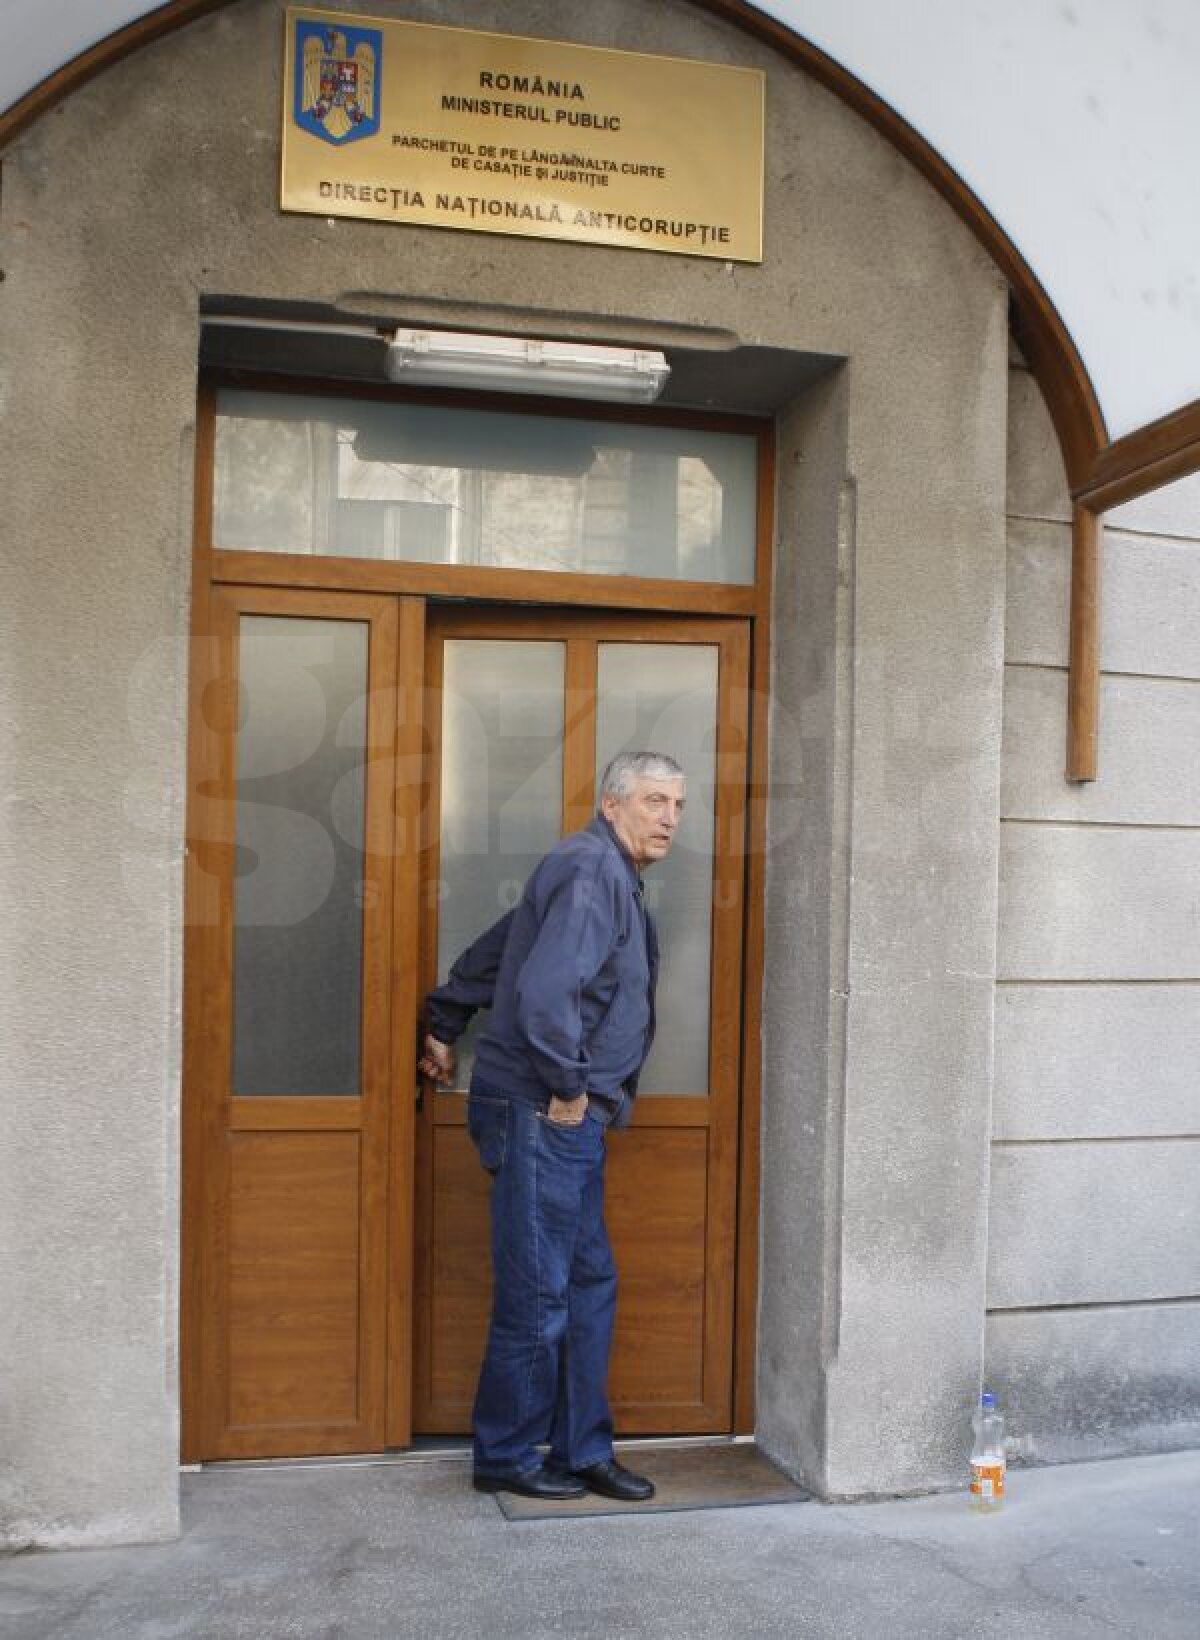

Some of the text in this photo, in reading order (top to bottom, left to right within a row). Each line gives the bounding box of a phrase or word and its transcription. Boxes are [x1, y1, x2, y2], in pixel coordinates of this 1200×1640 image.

[479, 71, 584, 101] ROMÂNIA
[441, 95, 621, 131] MINISTERUL PUBLIC
[391, 135, 474, 155] PARCHETUL
[477, 145, 497, 158] DE
[500, 147, 518, 161] PE
[621, 163, 665, 179] CURTE
[451, 157, 469, 169] DE
[319, 180, 425, 211] DIRECȚIA
[572, 207, 731, 245] ANTICORUPȚIE
